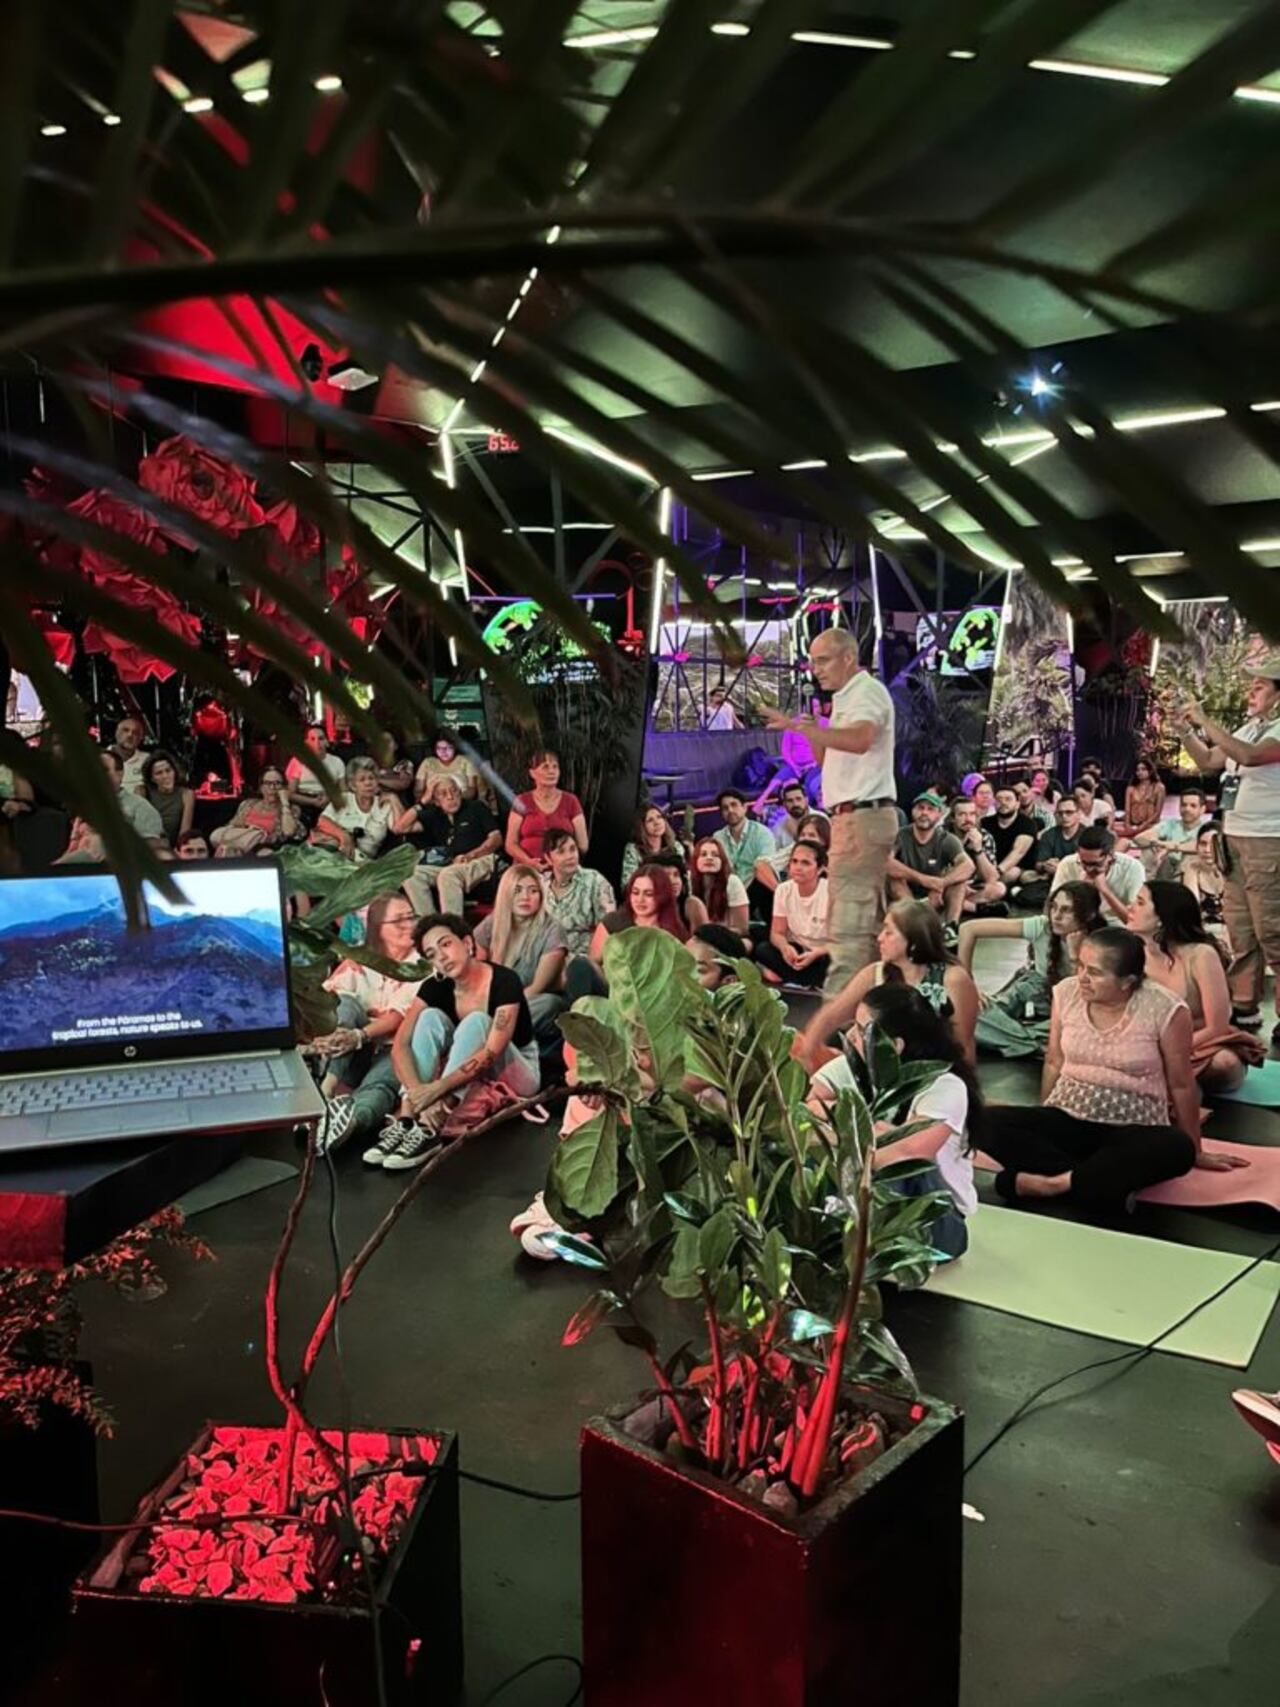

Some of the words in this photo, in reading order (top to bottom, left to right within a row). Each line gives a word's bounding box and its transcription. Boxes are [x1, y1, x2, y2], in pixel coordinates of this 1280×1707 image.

[76, 1018, 101, 1028] From
[102, 1016, 116, 1027] the
[156, 1013, 165, 1022] to
[166, 1011, 181, 1021] the
[120, 1023, 149, 1034] nature
